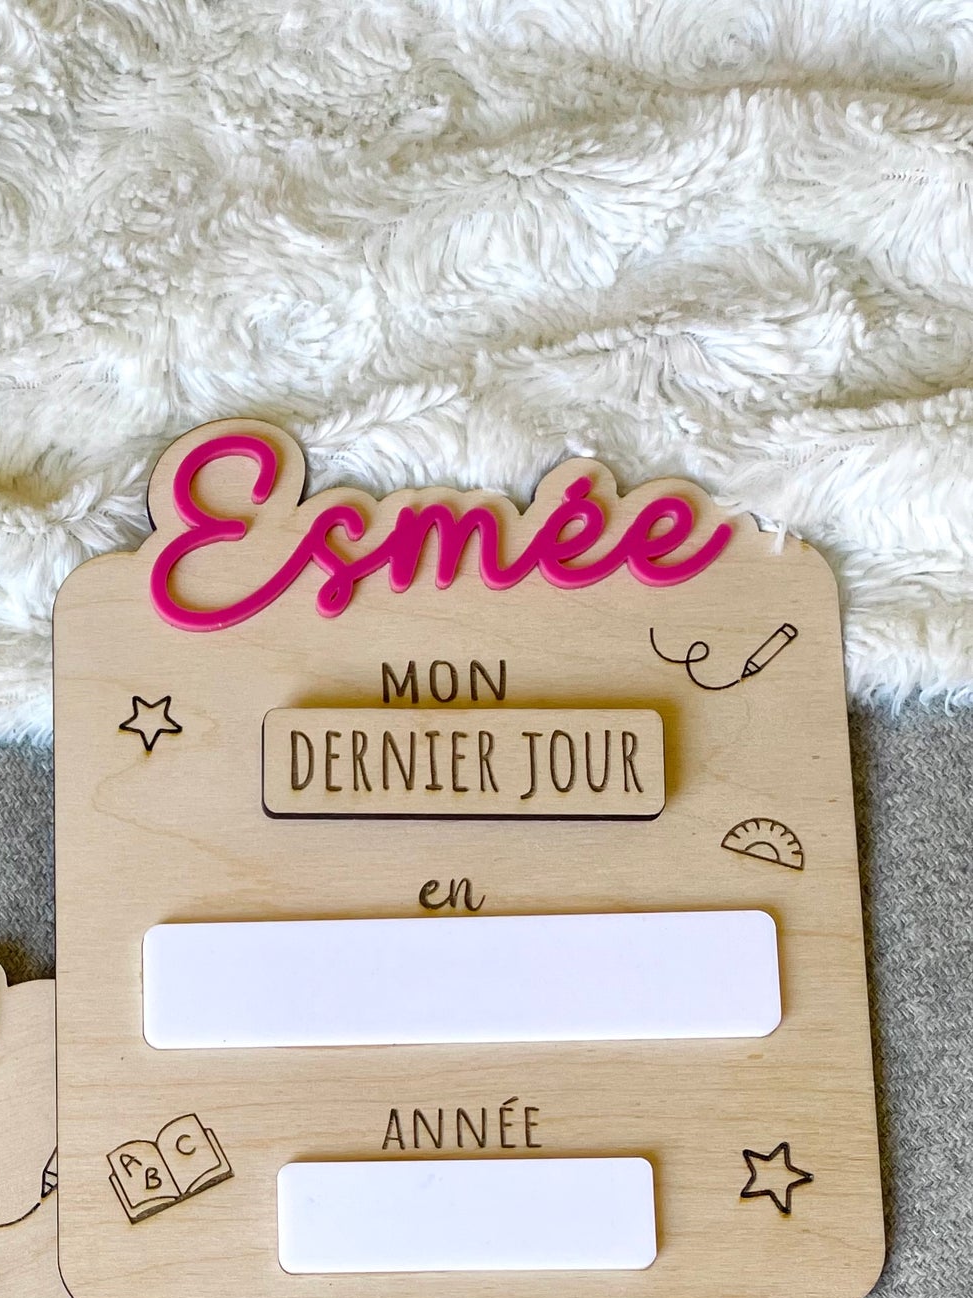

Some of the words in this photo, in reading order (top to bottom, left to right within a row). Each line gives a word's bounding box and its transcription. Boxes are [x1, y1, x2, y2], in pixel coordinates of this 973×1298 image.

[150, 434, 732, 632] Esmée
[381, 659, 507, 704] MON
[290, 729, 499, 793] DERNIER
[519, 730, 644, 799] JOUR
[418, 873, 486, 912] en
[382, 1096, 543, 1151] ANNÉE
